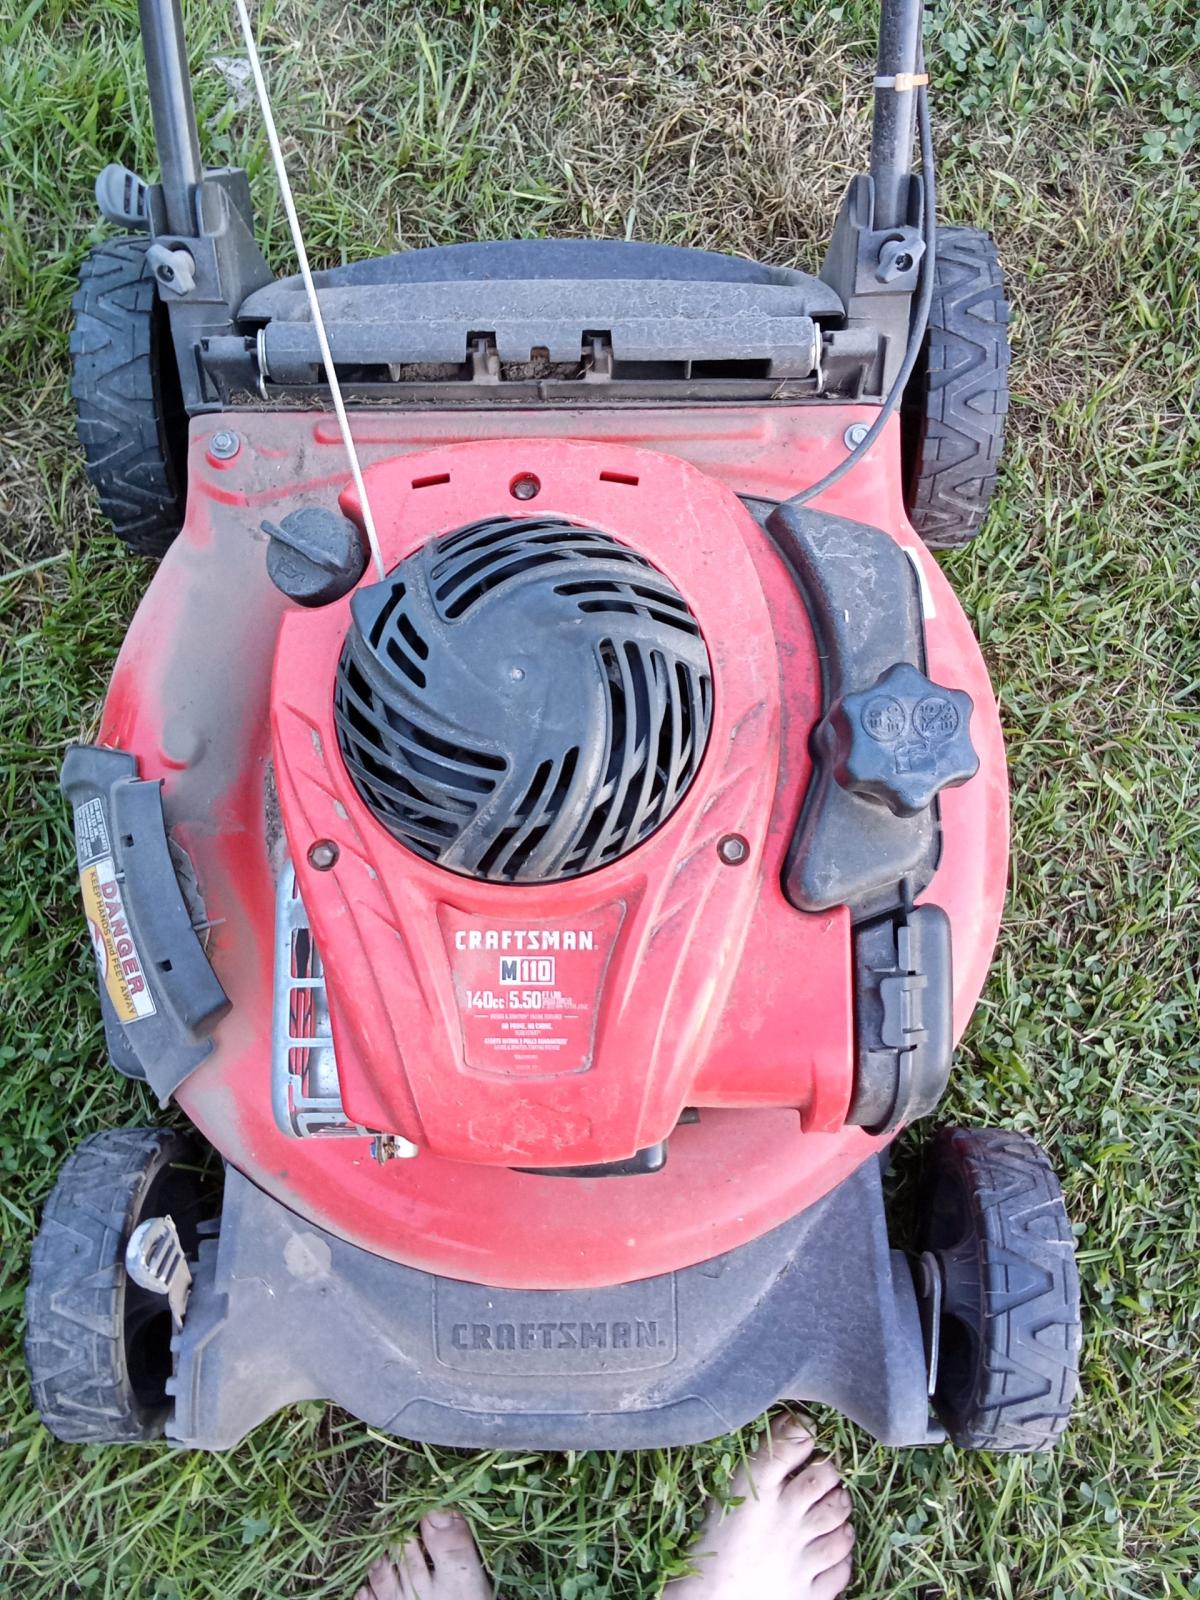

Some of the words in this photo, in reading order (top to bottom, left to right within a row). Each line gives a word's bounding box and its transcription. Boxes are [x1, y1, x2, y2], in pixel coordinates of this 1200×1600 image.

[89, 871, 101, 899] KEEP
[96, 900, 111, 936] HANDS
[101, 879, 145, 995] DANGER
[106, 936, 117, 956] and
[455, 930, 594, 950] CRAFTSMAN
[111, 957, 125, 984] FEET
[119, 985, 138, 1016] AWAY
[467, 990, 505, 1009] 140cc
[509, 990, 542, 1009] 5.50
